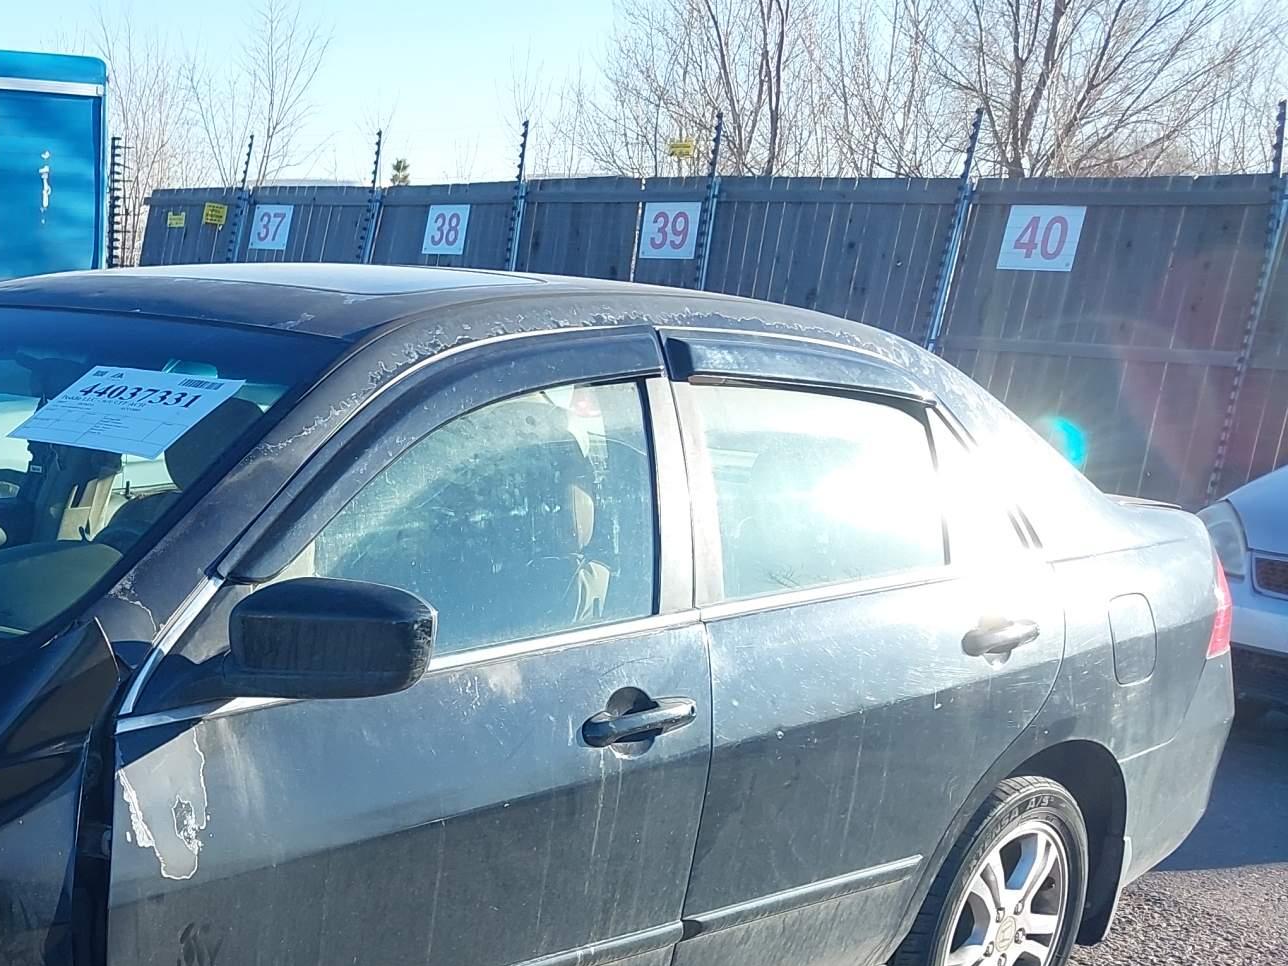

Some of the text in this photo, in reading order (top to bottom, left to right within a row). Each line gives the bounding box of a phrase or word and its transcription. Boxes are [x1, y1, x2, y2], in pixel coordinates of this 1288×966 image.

[257, 212, 287, 242] 37
[431, 213, 461, 246] 38
[650, 211, 690, 249] 39
[1013, 215, 1068, 260] 40
[79, 382, 202, 408] 44037331
